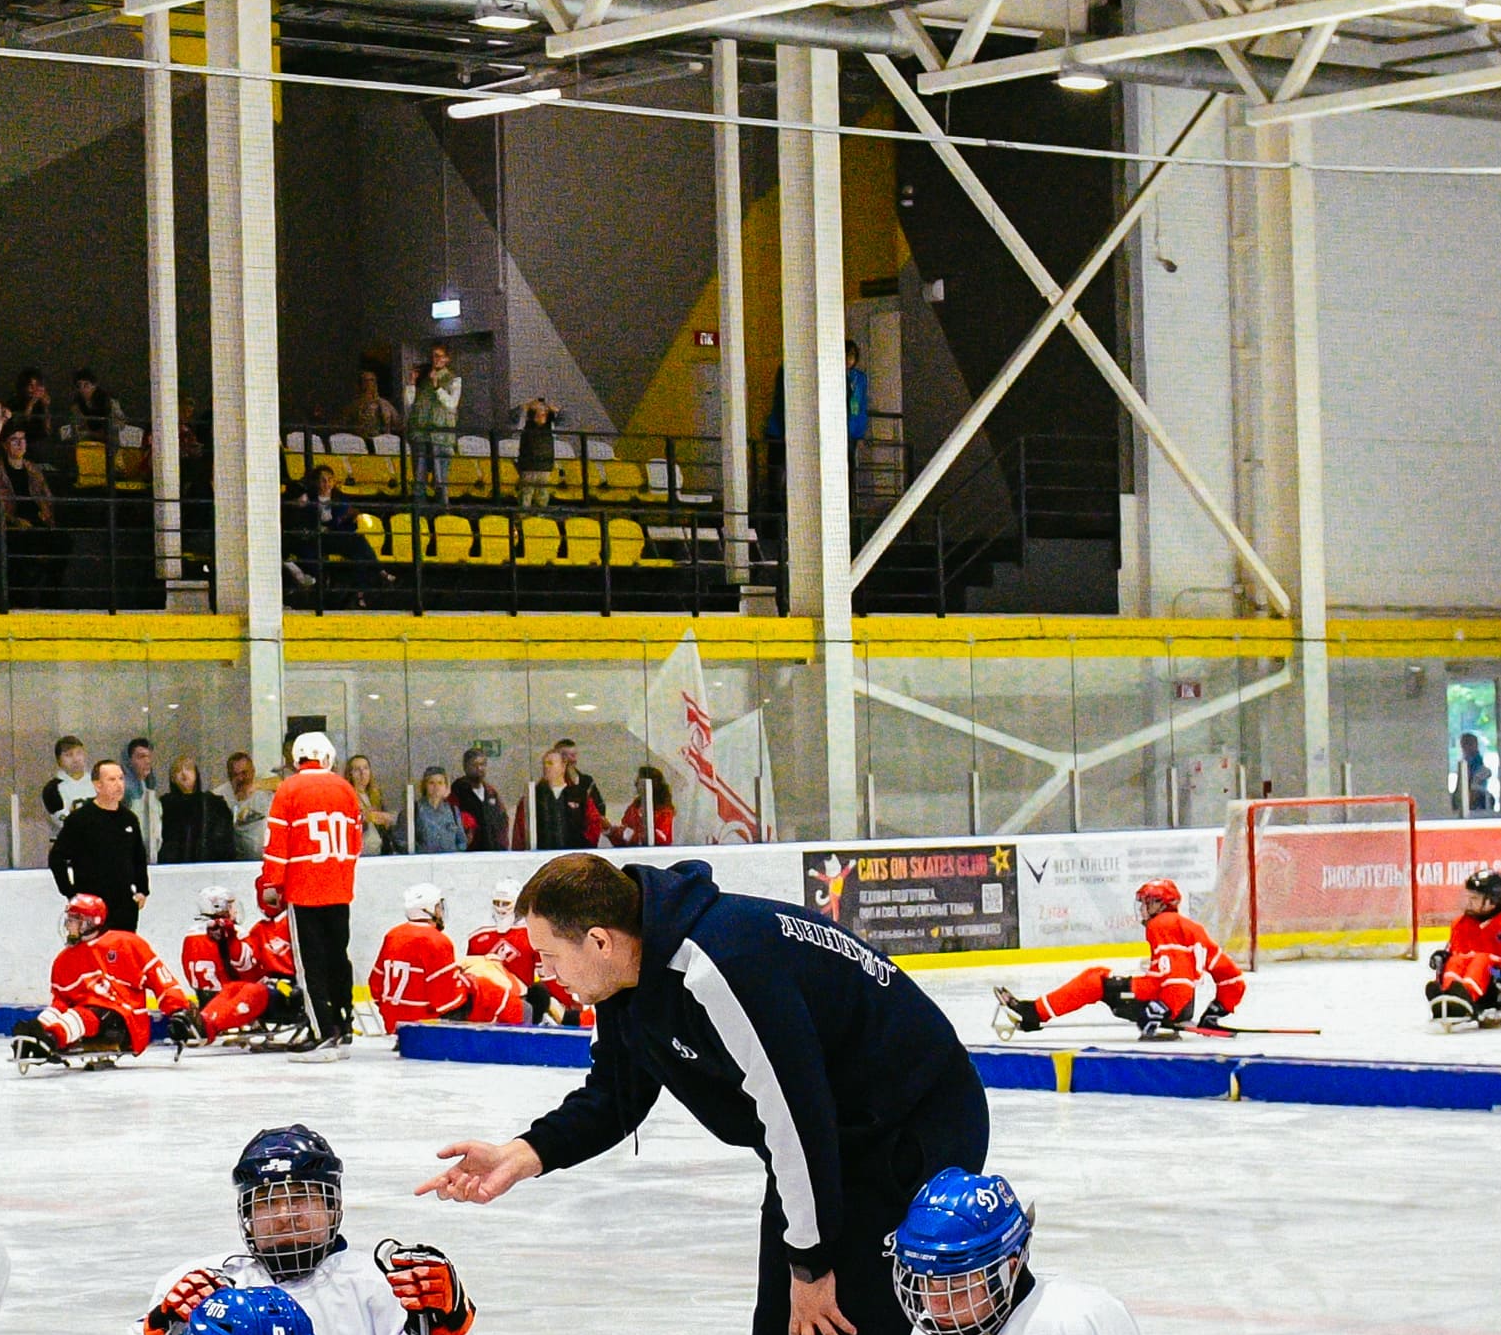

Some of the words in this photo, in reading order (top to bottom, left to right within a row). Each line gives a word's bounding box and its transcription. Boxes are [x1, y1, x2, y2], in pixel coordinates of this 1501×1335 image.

[307, 811, 349, 863] 50
[857, 857, 889, 882] CATS
[890, 857, 909, 881] ON
[910, 855, 956, 879] SKATES
[188, 960, 223, 992] 13
[383, 959, 411, 1006] 17
